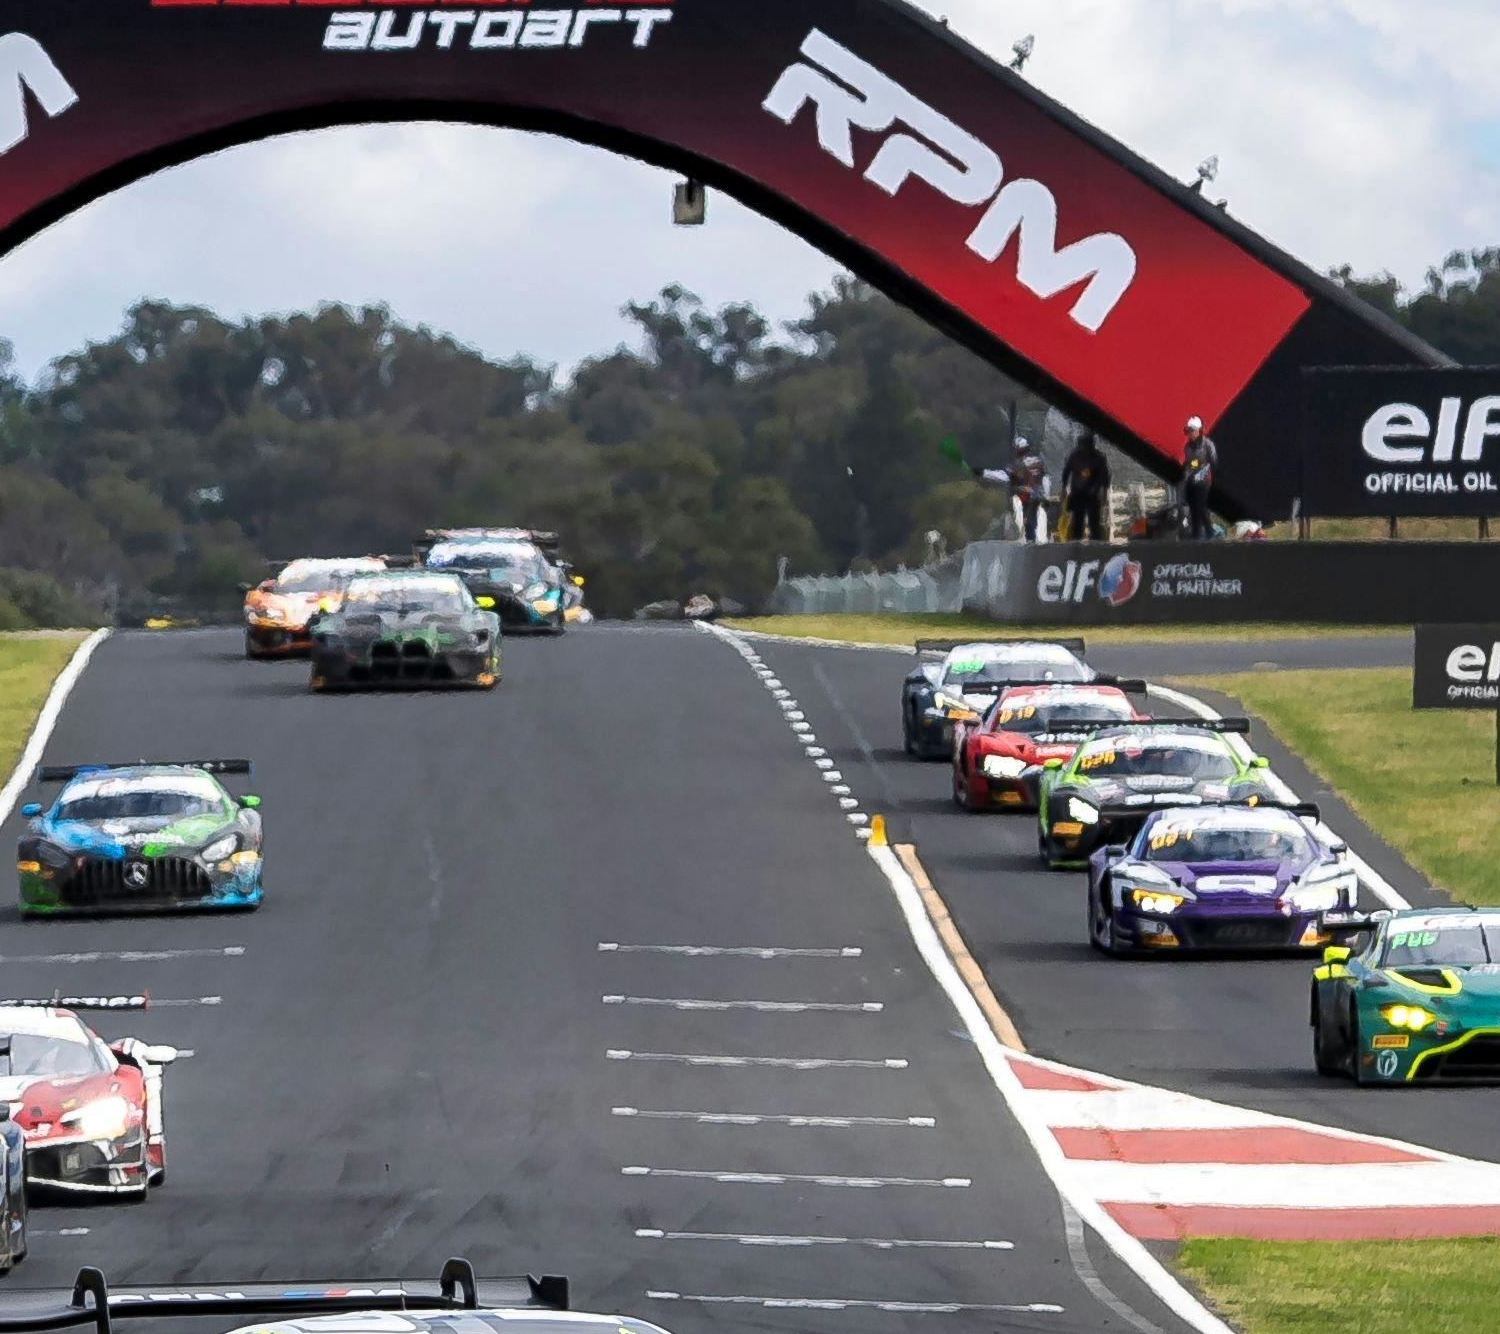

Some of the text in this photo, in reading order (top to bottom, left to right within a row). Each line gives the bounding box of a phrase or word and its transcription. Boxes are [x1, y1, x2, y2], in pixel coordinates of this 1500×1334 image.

[762, 27, 1137, 335] RPM
[1365, 473, 1458, 493] OFFICIAL
[1465, 472, 1496, 491] OIL
[1037, 560, 1099, 604] elf
